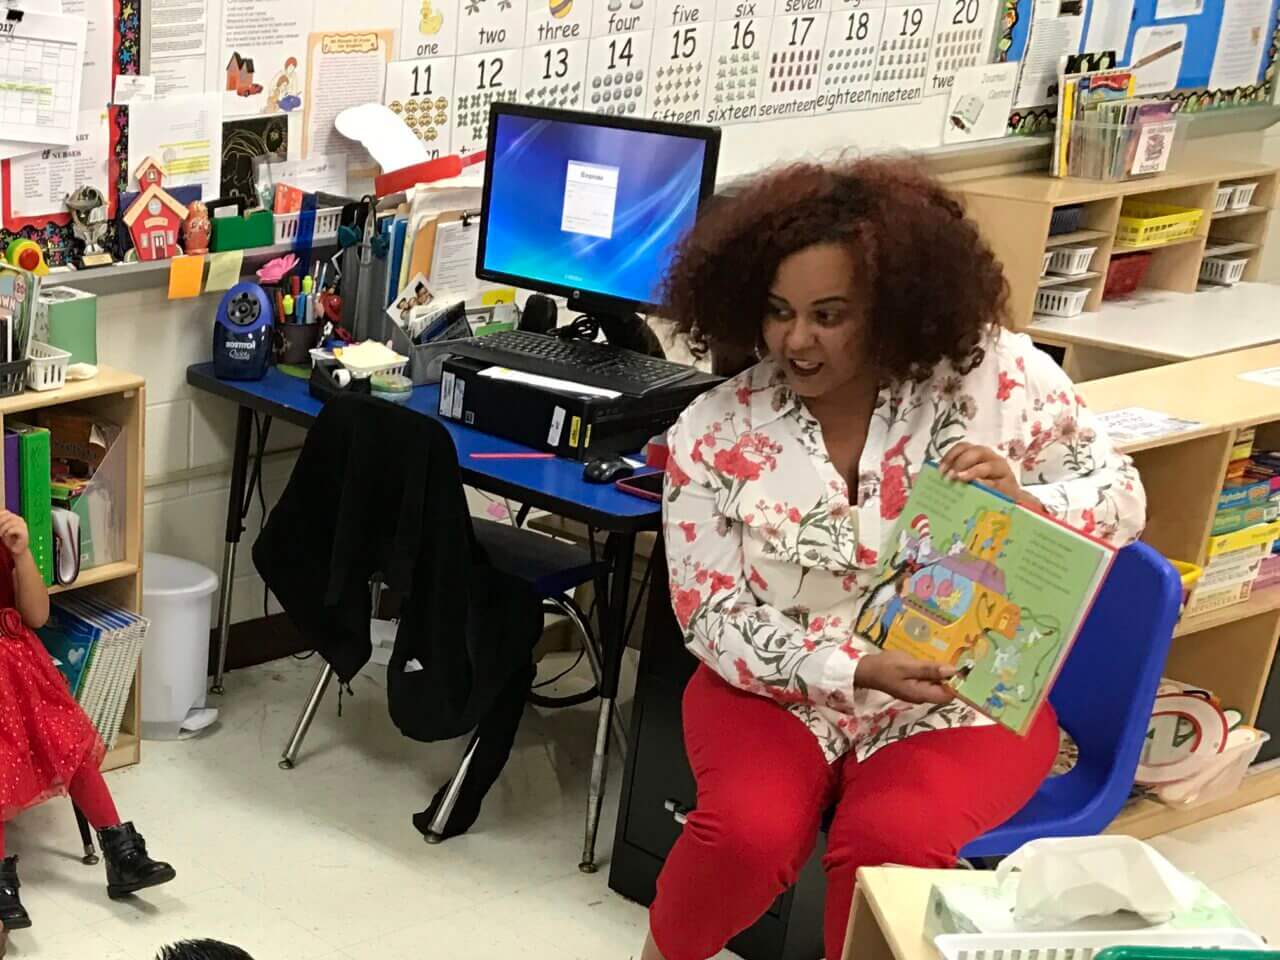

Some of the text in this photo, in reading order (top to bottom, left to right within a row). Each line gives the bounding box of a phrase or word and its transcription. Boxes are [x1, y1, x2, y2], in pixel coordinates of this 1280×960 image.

[411, 0, 979, 96] 11 12 13 14 15 16 17 18 19 20
[417, 42, 438, 56] one
[478, 27, 506, 45] two
[538, 21, 580, 41] three
[607, 13, 640, 33] four
[672, 5, 699, 25] five
[735, 1, 756, 18] six
[706, 103, 757, 124] sixteen
[759, 99, 816, 117] seventeen
[816, 89, 872, 111] eighteen
[872, 86, 922, 104] nineteen
[932, 73, 955, 89] twe
